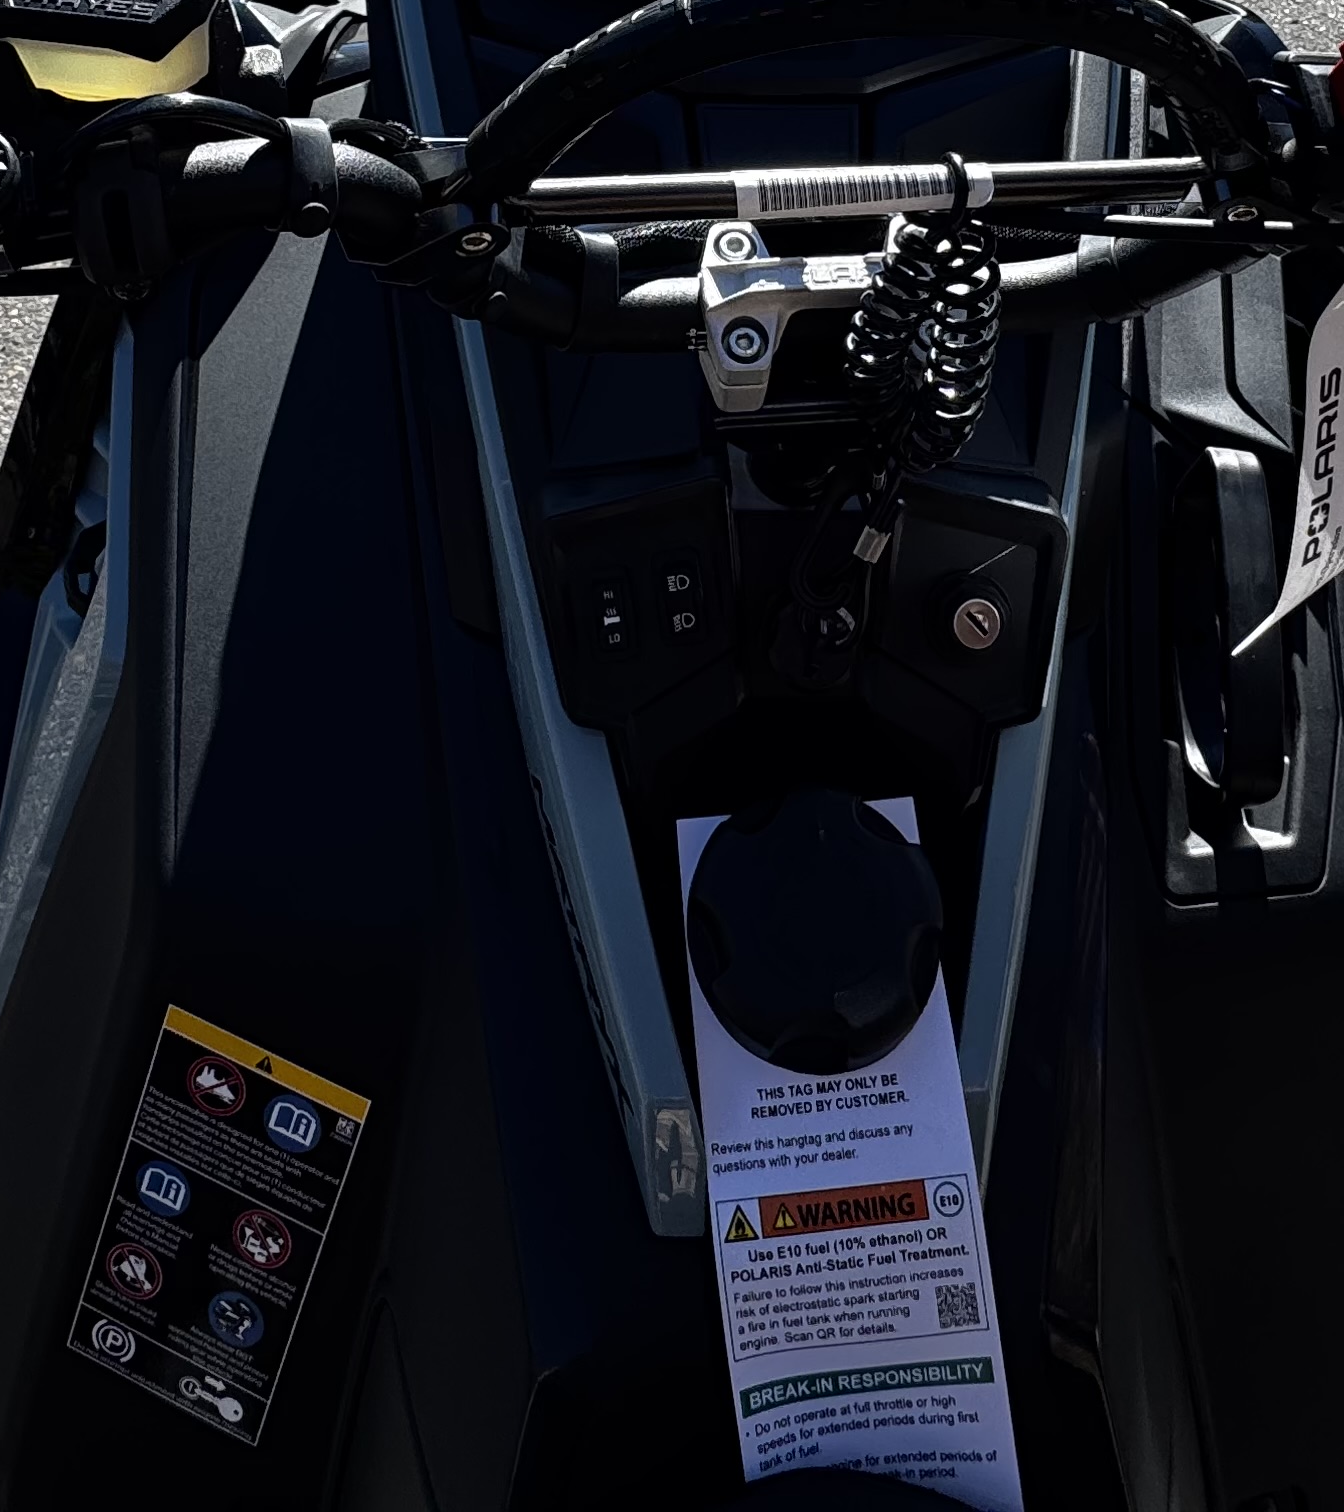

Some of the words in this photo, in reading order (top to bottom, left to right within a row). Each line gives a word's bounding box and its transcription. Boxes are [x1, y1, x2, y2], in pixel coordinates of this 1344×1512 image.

[1302, 366, 1342, 567] POLARIS
[602, 589, 613, 600] HI
[608, 632, 620, 644] LO
[756, 1086, 785, 1101] THIS
[787, 1082, 813, 1097] TAG
[815, 1079, 841, 1094] MAY
[844, 1075, 877, 1091] ONLY
[880, 1072, 898, 1086] BE
[750, 1101, 812, 1118] REMOVED
[815, 1098, 832, 1112] BY
[710, 1142, 751, 1155] Review
[753, 1138, 774, 1151] this
[776, 1133, 822, 1149] hangtag
[824, 1129, 845, 1143] and
[848, 1126, 890, 1140] discuss
[893, 1124, 913, 1137] any
[712, 1158, 766, 1175] questions
[767, 1153, 791, 1167] with
[793, 1152, 818, 1168] your
[797, 1192, 915, 1227] WARNING
[939, 1193, 959, 1207] E10
[747, 1249, 774, 1262] Use
[776, 1244, 801, 1259] E10
[804, 1240, 830, 1255] fuel
[833, 1235, 865, 1254] (10%
[868, 1229, 923, 1247] ethanol)
[925, 1226, 947, 1240] OR
[730, 1264, 792, 1283] POLARIS
[795, 1256, 864, 1275] Anti-Static
[867, 1250, 896, 1266] Fuel
[733, 1290, 772, 1303] Failure
[774, 1288, 787, 1298] to
[788, 1284, 822, 1296] follow
[824, 1280, 845, 1292] this
[848, 1274, 906, 1289] instruction
[909, 1267, 963, 1281] increases
[735, 1307, 755, 1319] risk
[758, 1304, 769, 1316] of
[772, 1297, 841, 1313] electrostatic
[843, 1292, 875, 1307] spark
[877, 1288, 920, 1302] starting
[737, 1324, 745, 1335] a
[747, 1321, 766, 1332] fire
[768, 1319, 780, 1329] in
[781, 1316, 803, 1327] fuel
[805, 1313, 831, 1325] tank
[833, 1311, 864, 1322] when
[866, 1305, 910, 1319] running
[784, 1331, 813, 1343] Scan
[816, 1326, 836, 1339] QR
[838, 1326, 853, 1337] for
[749, 1377, 833, 1409] BREAK-IN
[837, 1362, 984, 1391] RESPONSIBILITY
[754, 1422, 771, 1437] Do
[772, 1415, 791, 1430] not
[793, 1407, 837, 1424] operate
[839, 1403, 851, 1416] at
[852, 1400, 871, 1414] full
[872, 1398, 913, 1411] throttle
[915, 1398, 927, 1408] or
[930, 1394, 956, 1409] high
[756, 1433, 797, 1454] speeds
[798, 1427, 814, 1440] for
[817, 1417, 870, 1436] extended
[872, 1414, 915, 1429] periods
[917, 1412, 955, 1426] during
[956, 1410, 979, 1423] first
[758, 1453, 782, 1472] tank
[784, 1448, 796, 1462] of
[864, 1454, 879, 1467] for
[883, 1450, 936, 1464] extended
[939, 1450, 982, 1462] periods
[984, 1449, 997, 1462] of
